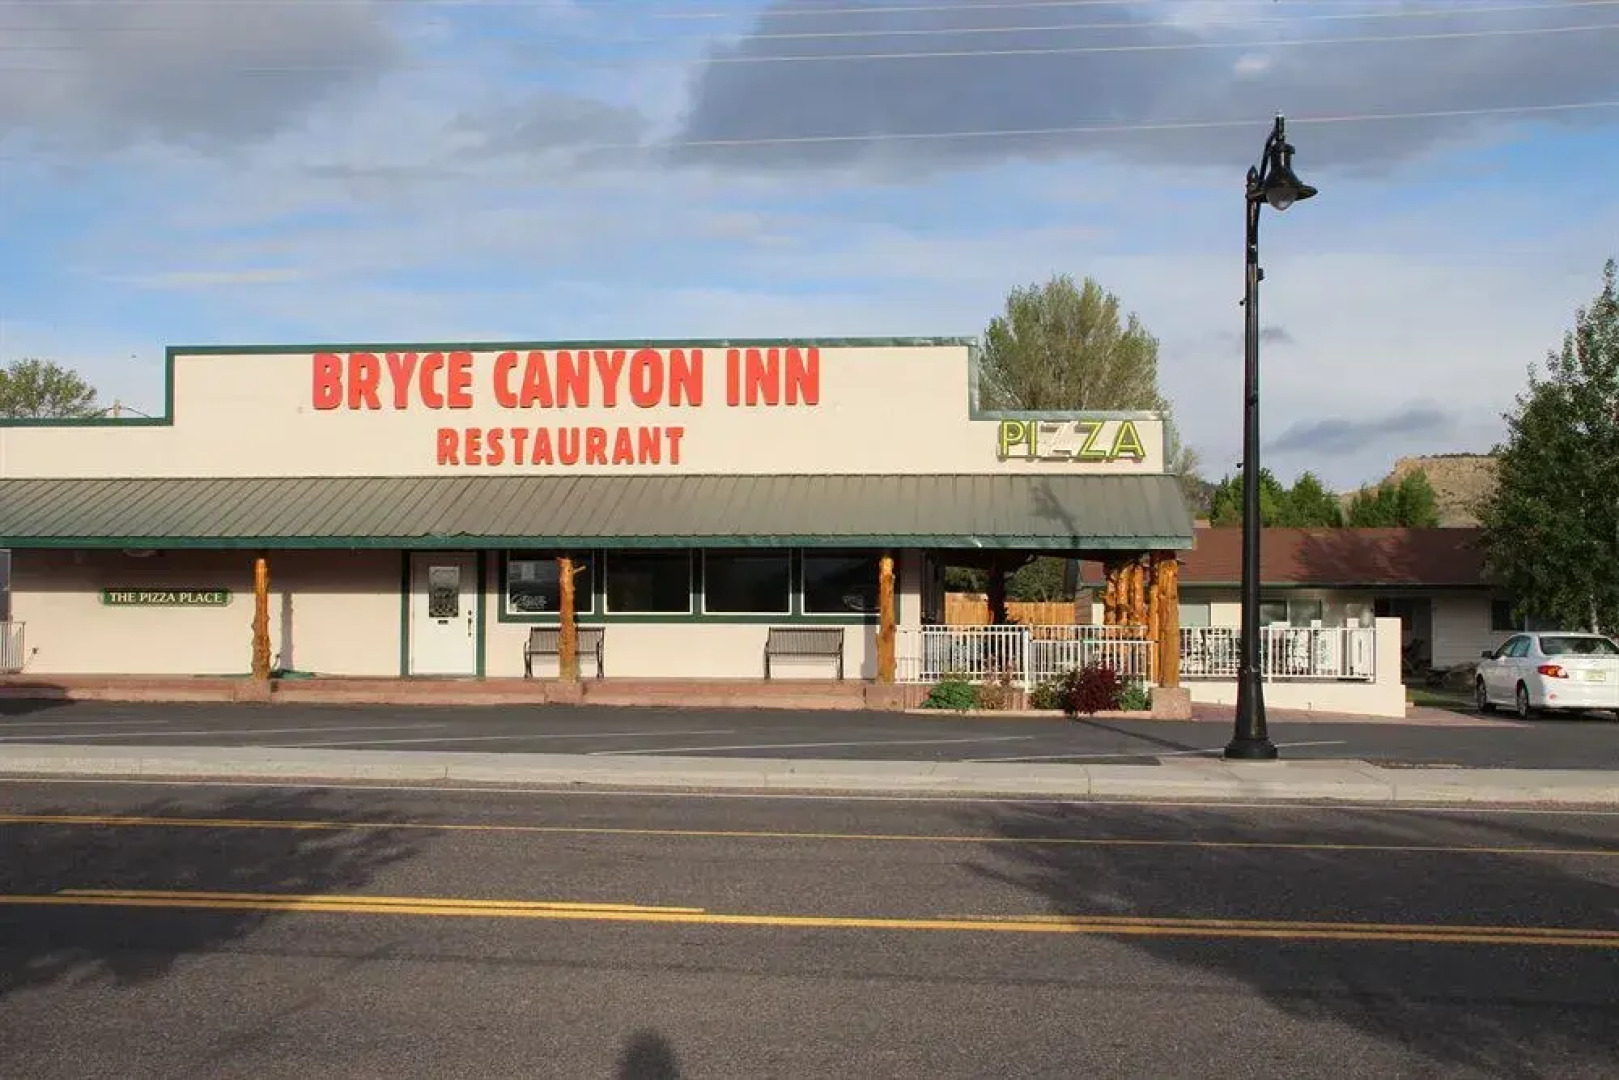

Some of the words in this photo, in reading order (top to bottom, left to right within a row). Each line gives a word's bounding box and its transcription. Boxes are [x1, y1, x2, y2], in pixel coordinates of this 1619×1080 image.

[312, 351, 473, 411] BRYCE
[493, 348, 704, 409] CANYON
[726, 346, 820, 407] INN
[437, 426, 685, 466] RESTAURANT
[999, 418, 1147, 459] PIZZA
[109, 592, 137, 603] THE
[140, 592, 176, 603] PIZZA
[180, 592, 223, 603] PLACE
